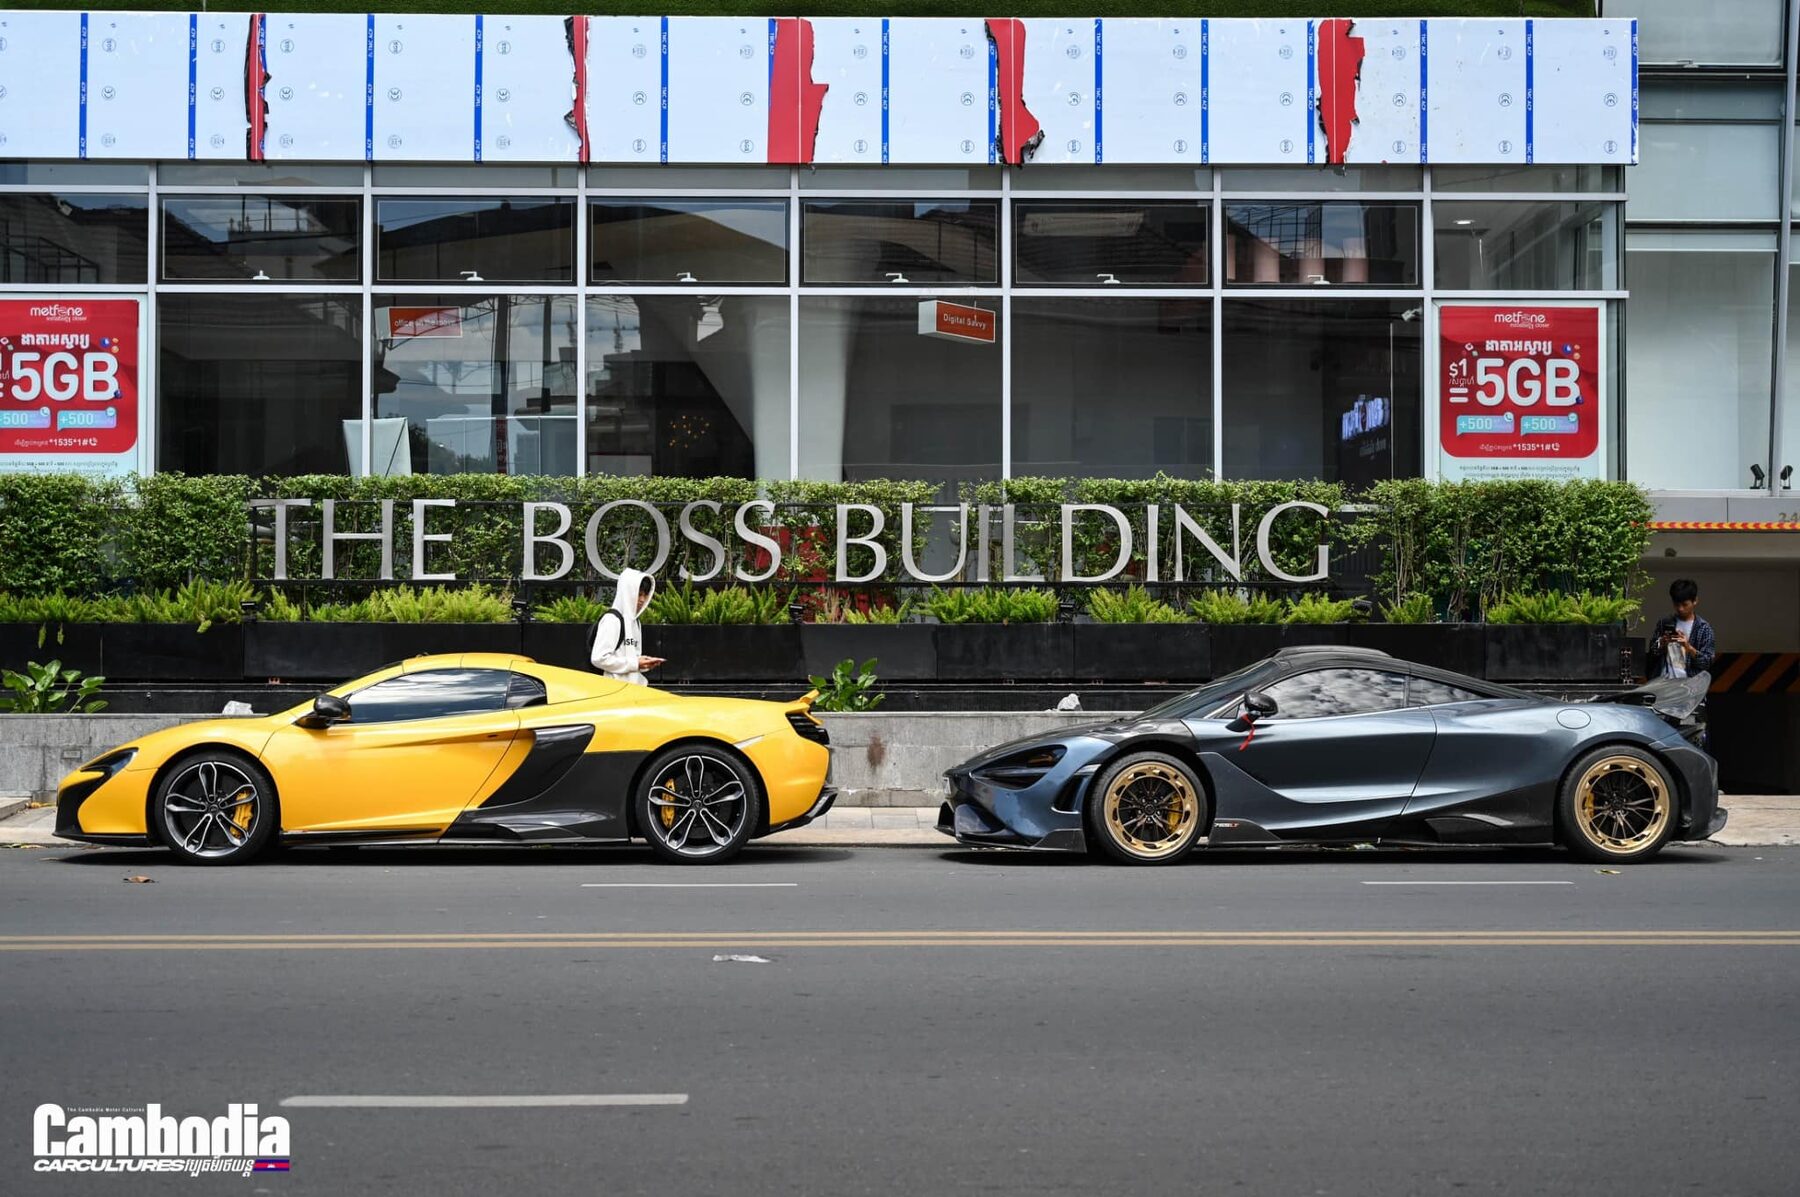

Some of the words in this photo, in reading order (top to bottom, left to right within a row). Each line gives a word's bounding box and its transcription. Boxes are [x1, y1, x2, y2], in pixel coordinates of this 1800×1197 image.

[943, 313, 965, 325] Digital
[967, 318, 986, 330] Savvy
[11, 351, 120, 401] 5GB
[1449, 358, 1467, 378] $1
[1476, 357, 1581, 407] 5GB
[60, 412, 95, 425] +500
[1460, 418, 1493, 430] +500
[1523, 418, 1556, 431] +500
[250, 498, 456, 581] THE
[523, 499, 782, 582] BOSS
[836, 500, 1329, 582] BUILDING
